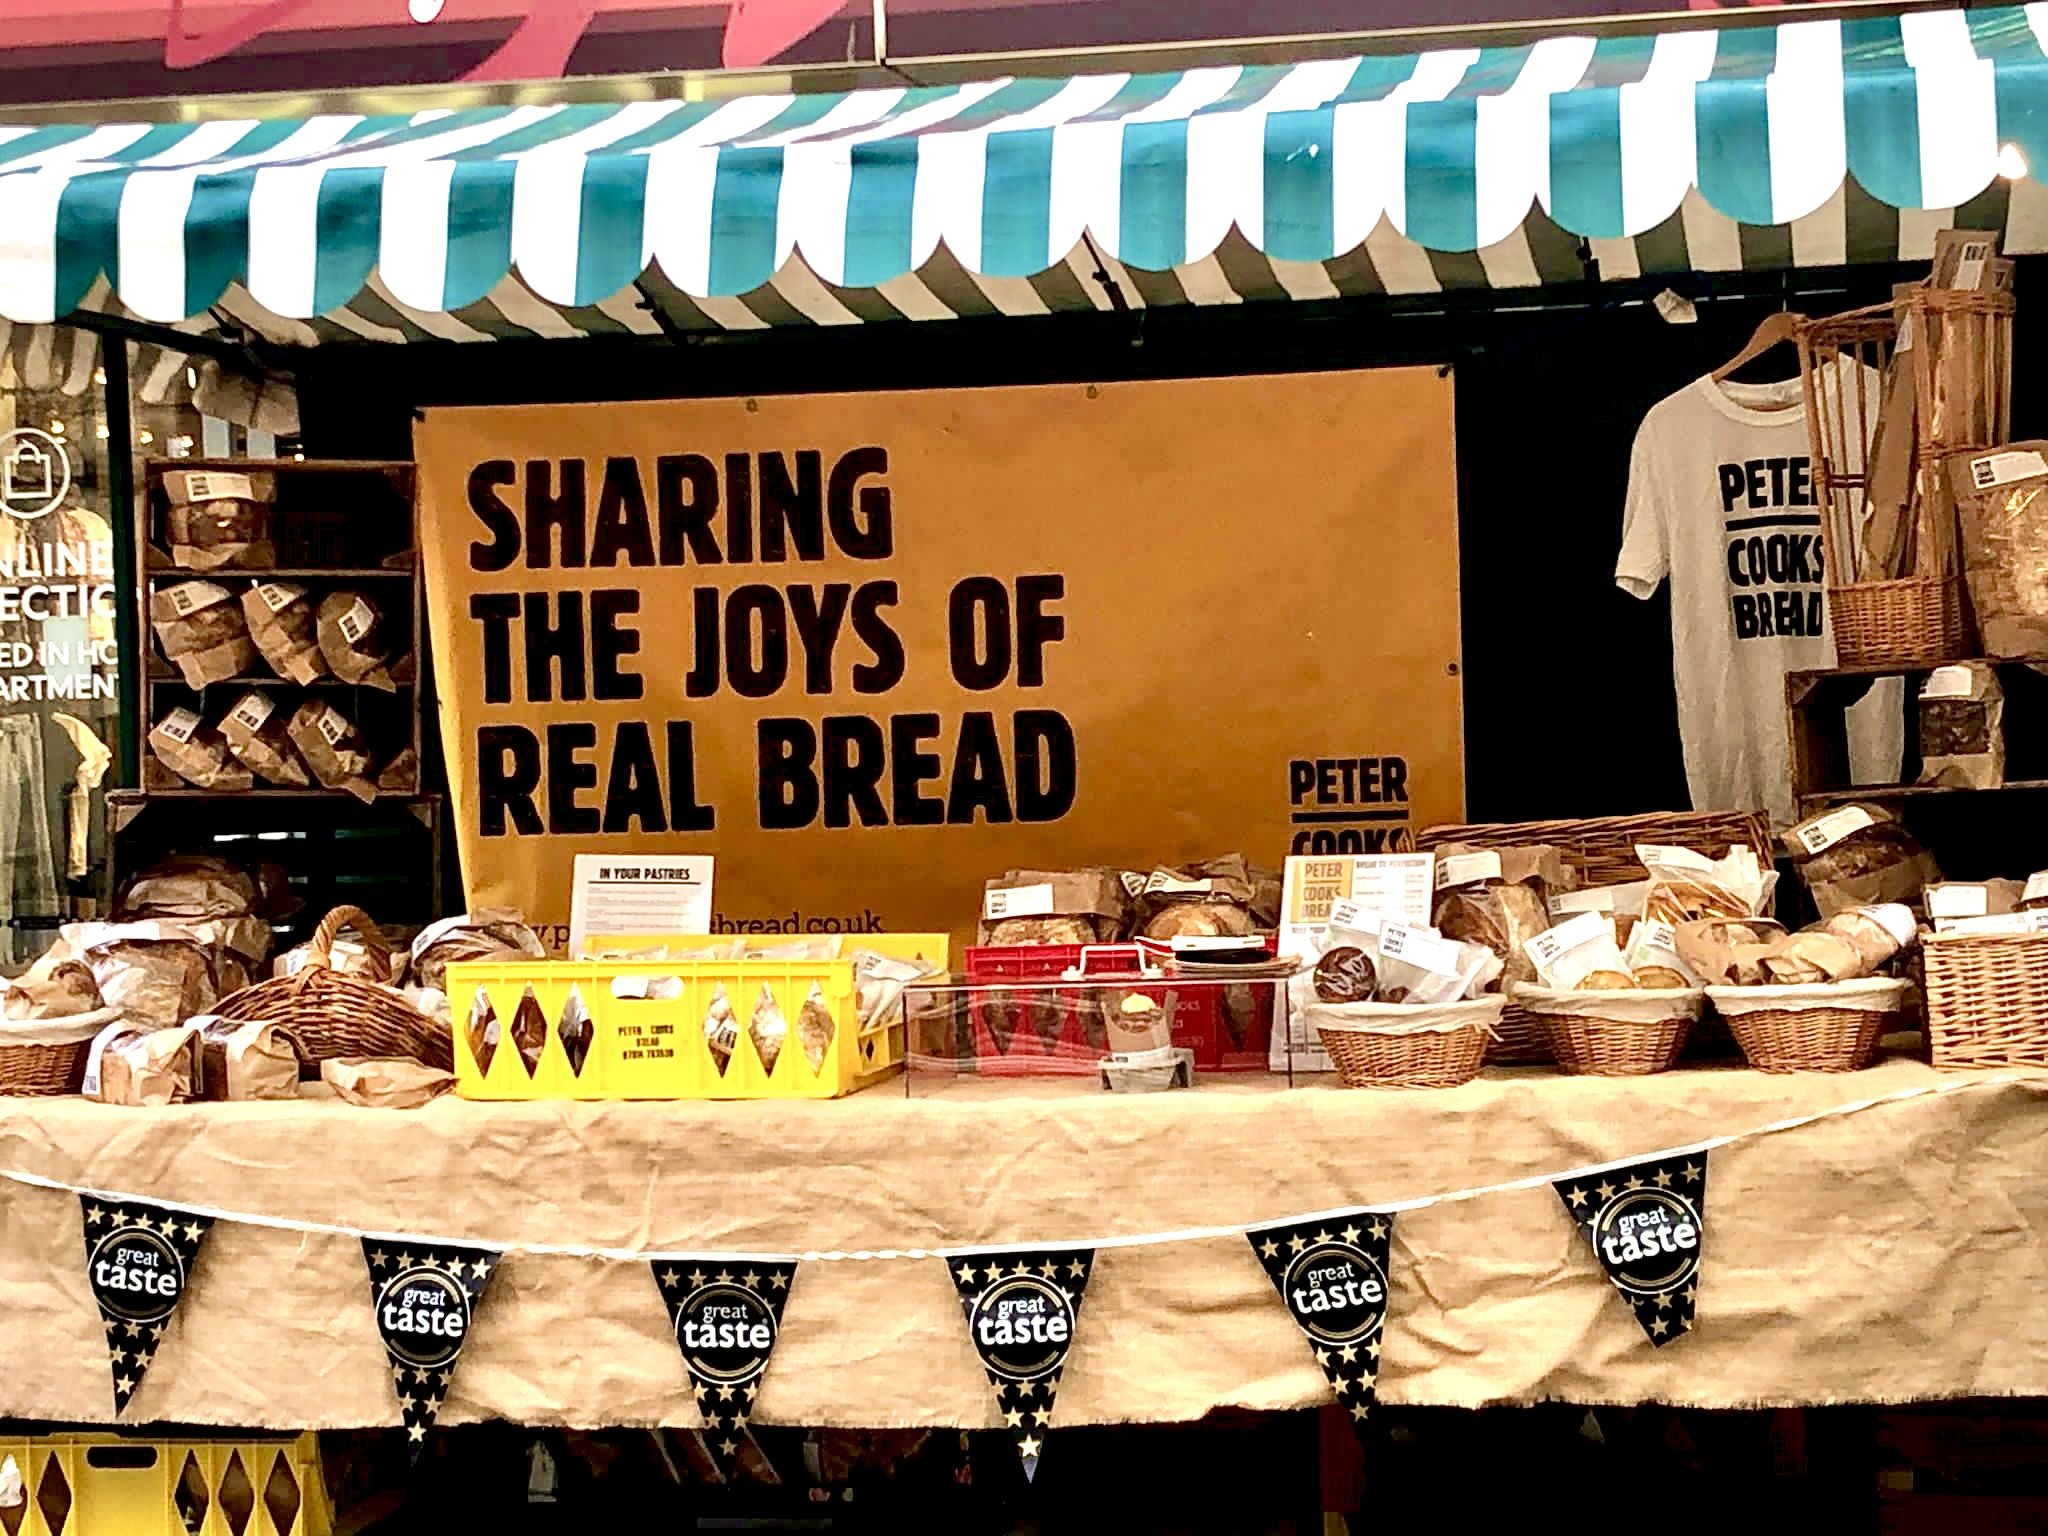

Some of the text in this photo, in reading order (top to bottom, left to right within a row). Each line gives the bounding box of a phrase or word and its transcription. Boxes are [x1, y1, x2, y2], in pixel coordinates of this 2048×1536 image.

[467, 447, 893, 571] SHARING
[1728, 534, 1824, 587] COOKS
[1733, 591, 1823, 639] BREAD
[40, 641, 69, 666] IN
[470, 575, 1065, 704] THE JOYS OF
[0, 673, 119, 701] ARTMEN
[478, 710, 1076, 836] REAL BREAD
[1289, 757, 1408, 805] PETER
[600, 868, 690, 880] IN YOUR PASTRIES
[1305, 862, 1343, 877] PETER
[1618, 1206, 1669, 1236] great
[115, 1248, 159, 1267] great
[1602, 1223, 1697, 1264] taste
[96, 1260, 176, 1296] taste
[1308, 1262, 1355, 1288] great
[402, 1288, 446, 1307] great
[997, 1295, 1046, 1319] great
[1292, 1280, 1382, 1313] taste
[383, 1302, 463, 1337] taste
[703, 1304, 748, 1324] great
[683, 1320, 770, 1348] taste
[978, 1314, 1068, 1345] taste
